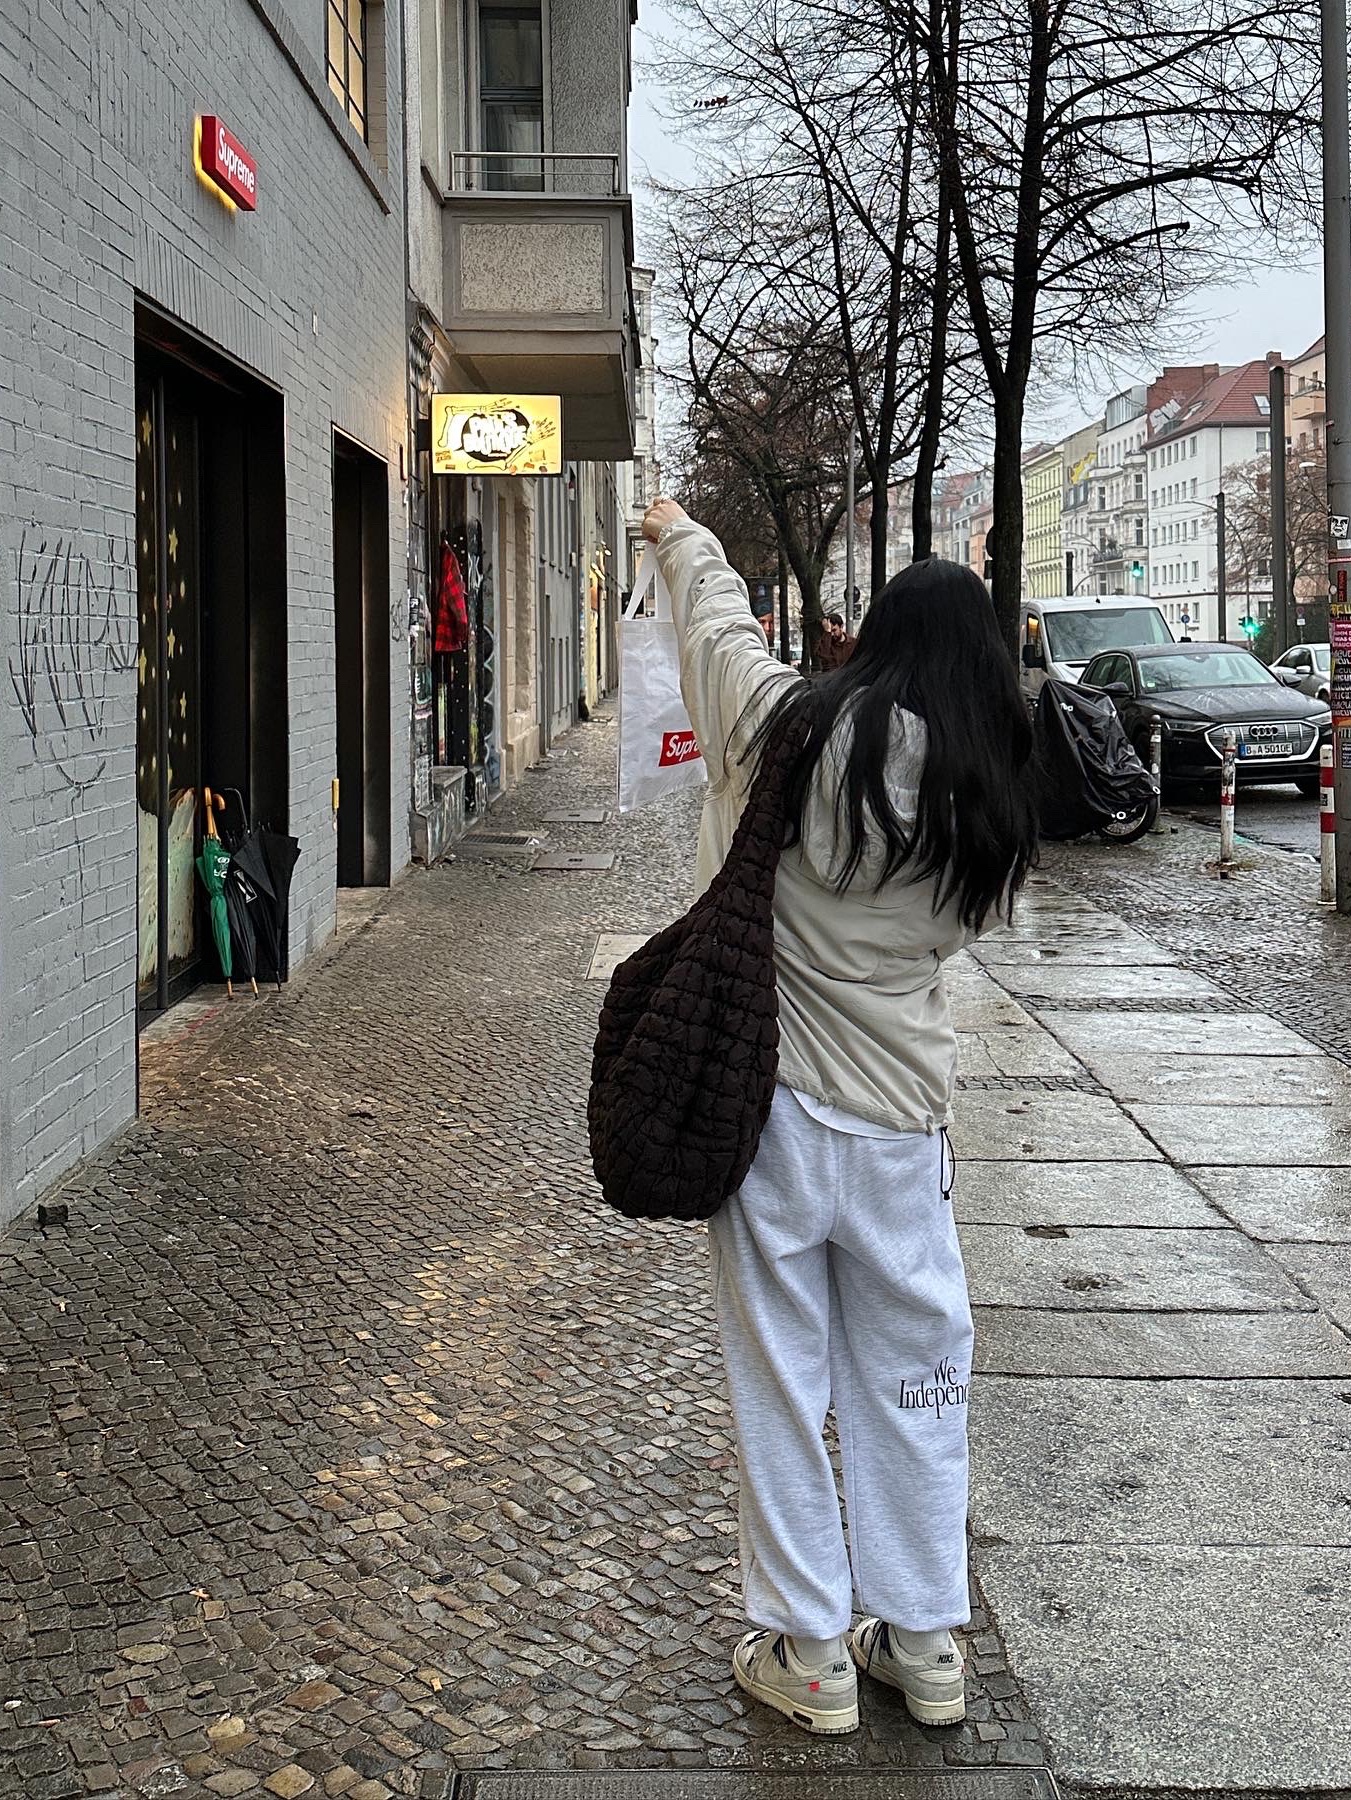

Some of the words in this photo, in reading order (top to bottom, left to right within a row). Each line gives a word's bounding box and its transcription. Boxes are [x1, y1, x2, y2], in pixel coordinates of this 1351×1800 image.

[218, 127, 255, 194] Supreme
[1246, 745, 1252, 755] B
[934, 1356, 957, 1386] We
[937, 1653, 955, 1664] NIKE
[831, 1661, 848, 1674] NIKE
